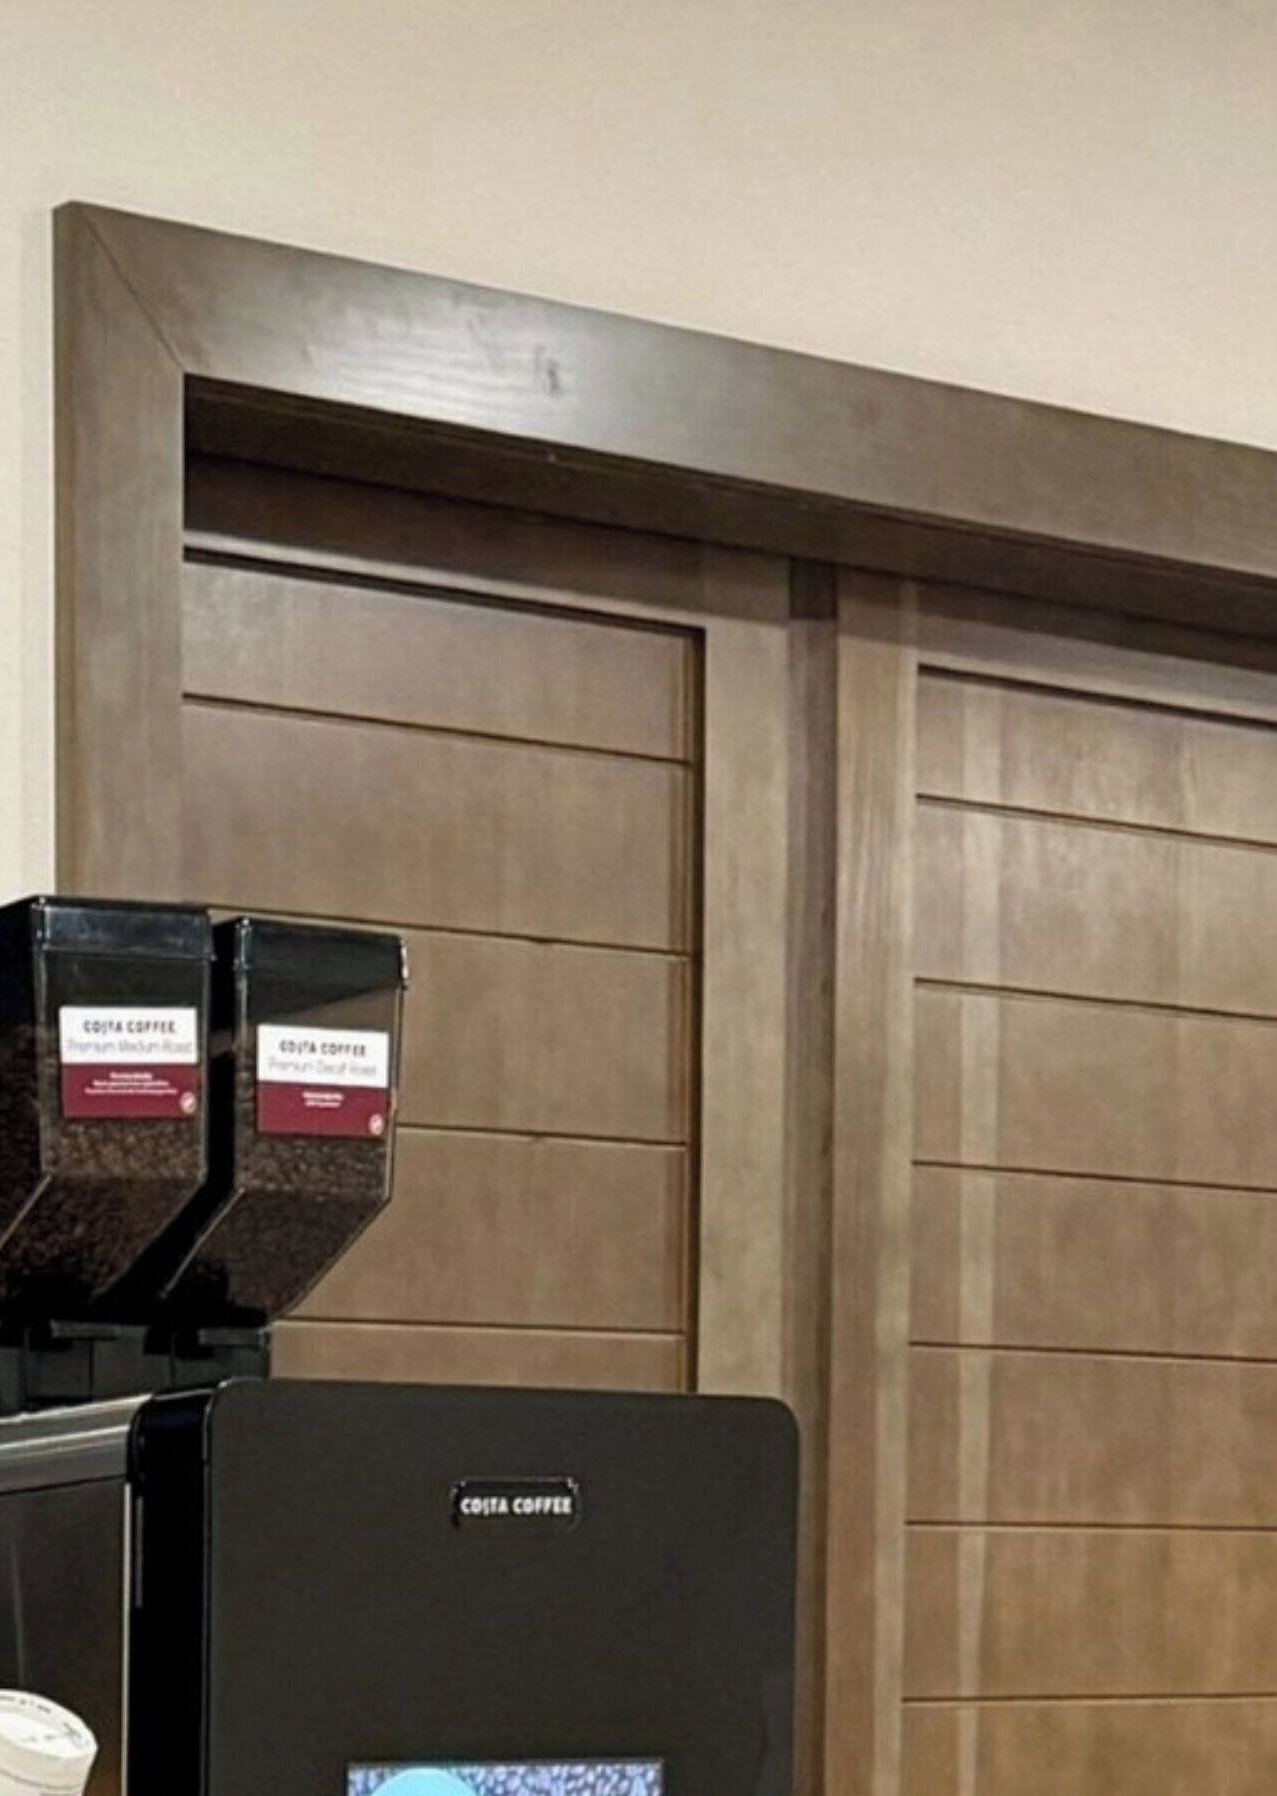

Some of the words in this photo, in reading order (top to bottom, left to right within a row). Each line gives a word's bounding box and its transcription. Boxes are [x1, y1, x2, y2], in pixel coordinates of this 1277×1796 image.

[83, 1020, 123, 1035] COSTA
[126, 1020, 176, 1034] COFFEE
[279, 1039, 316, 1056] COSTA
[321, 1041, 367, 1057] COFFEE
[459, 1496, 509, 1517] COSTA
[512, 1496, 572, 1515] COFFEE
